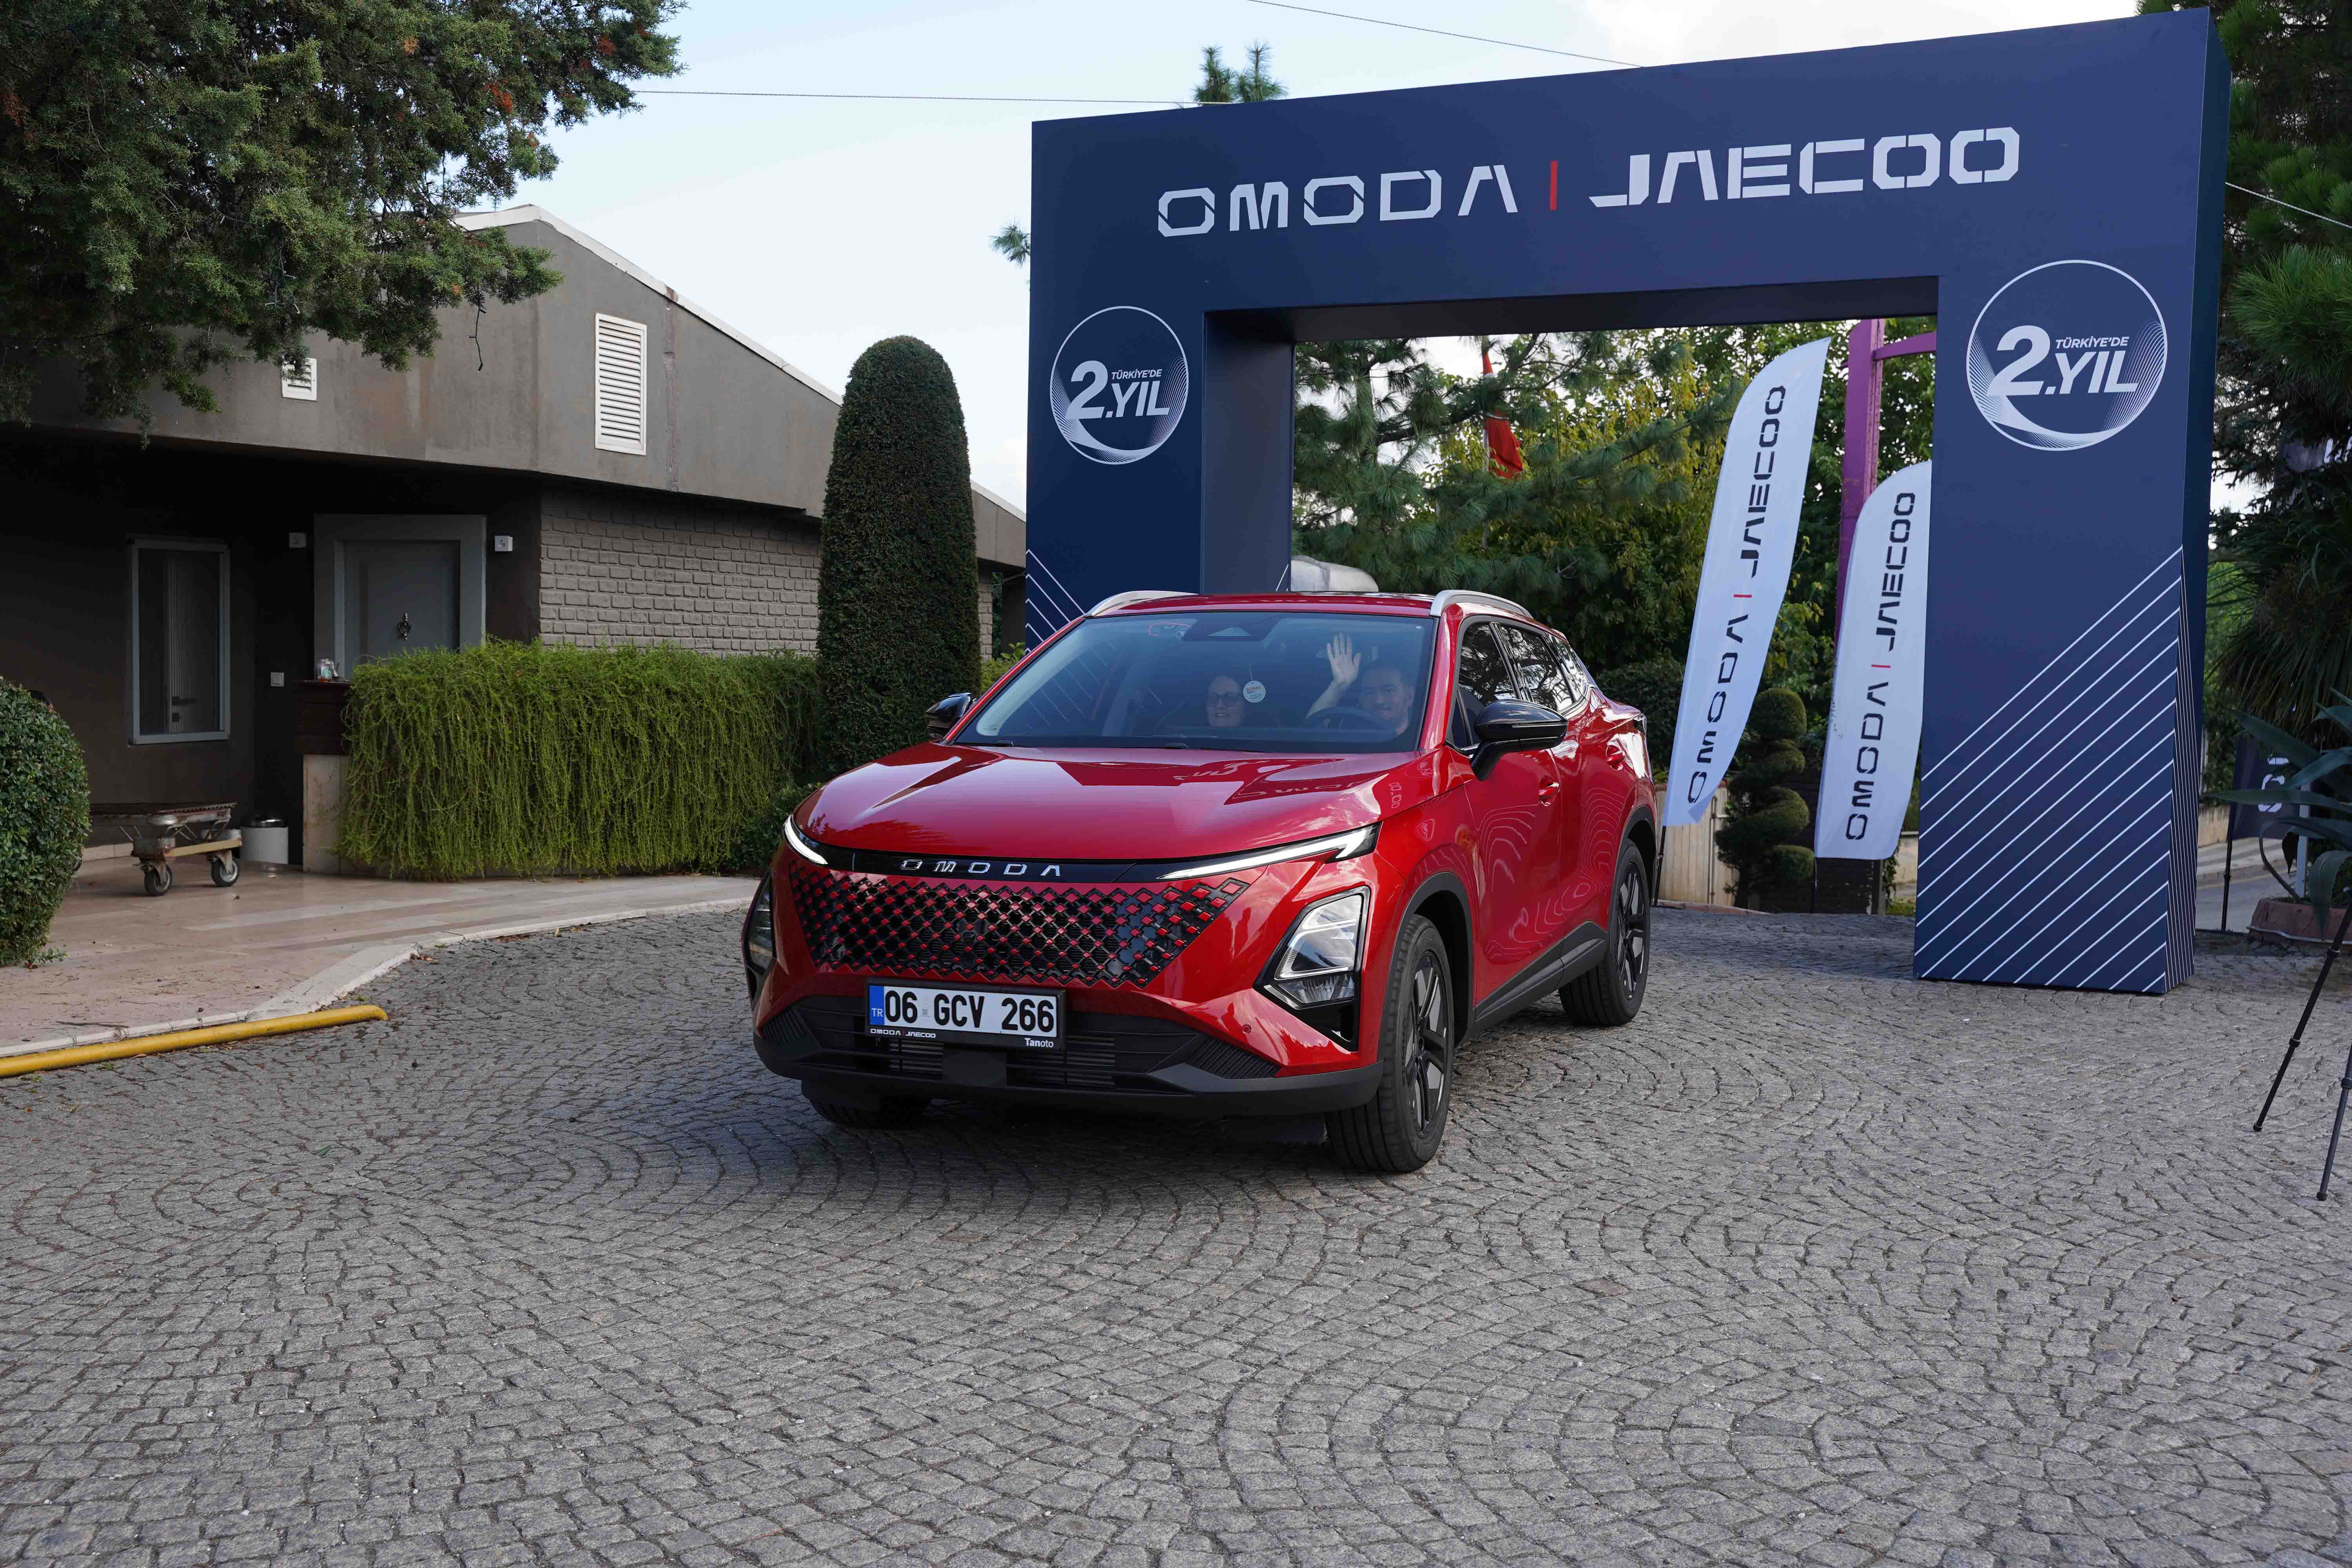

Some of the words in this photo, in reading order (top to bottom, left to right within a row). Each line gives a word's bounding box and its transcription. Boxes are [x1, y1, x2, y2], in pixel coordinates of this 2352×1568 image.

[1158, 165, 1518, 237] OMODA
[1589, 127, 2020, 208] JAECOO
[2055, 336, 2130, 349] TÜRKİYE'DE
[1111, 368, 1163, 380] TÜRKİYE'DE
[1688, 614, 1749, 804] OMODA
[1740, 386, 1786, 579] JAECOO
[1845, 682, 1889, 840] OMODA
[1875, 493, 1915, 652] JAECOO
[901, 859, 1060, 877] OMODA
[871, 1008, 884, 1017] TR
[885, 990, 918, 1023] 06
[934, 993, 985, 1028] GCV
[1002, 997, 1054, 1033] 266
[1024, 1038, 1054, 1047] Tanoto
